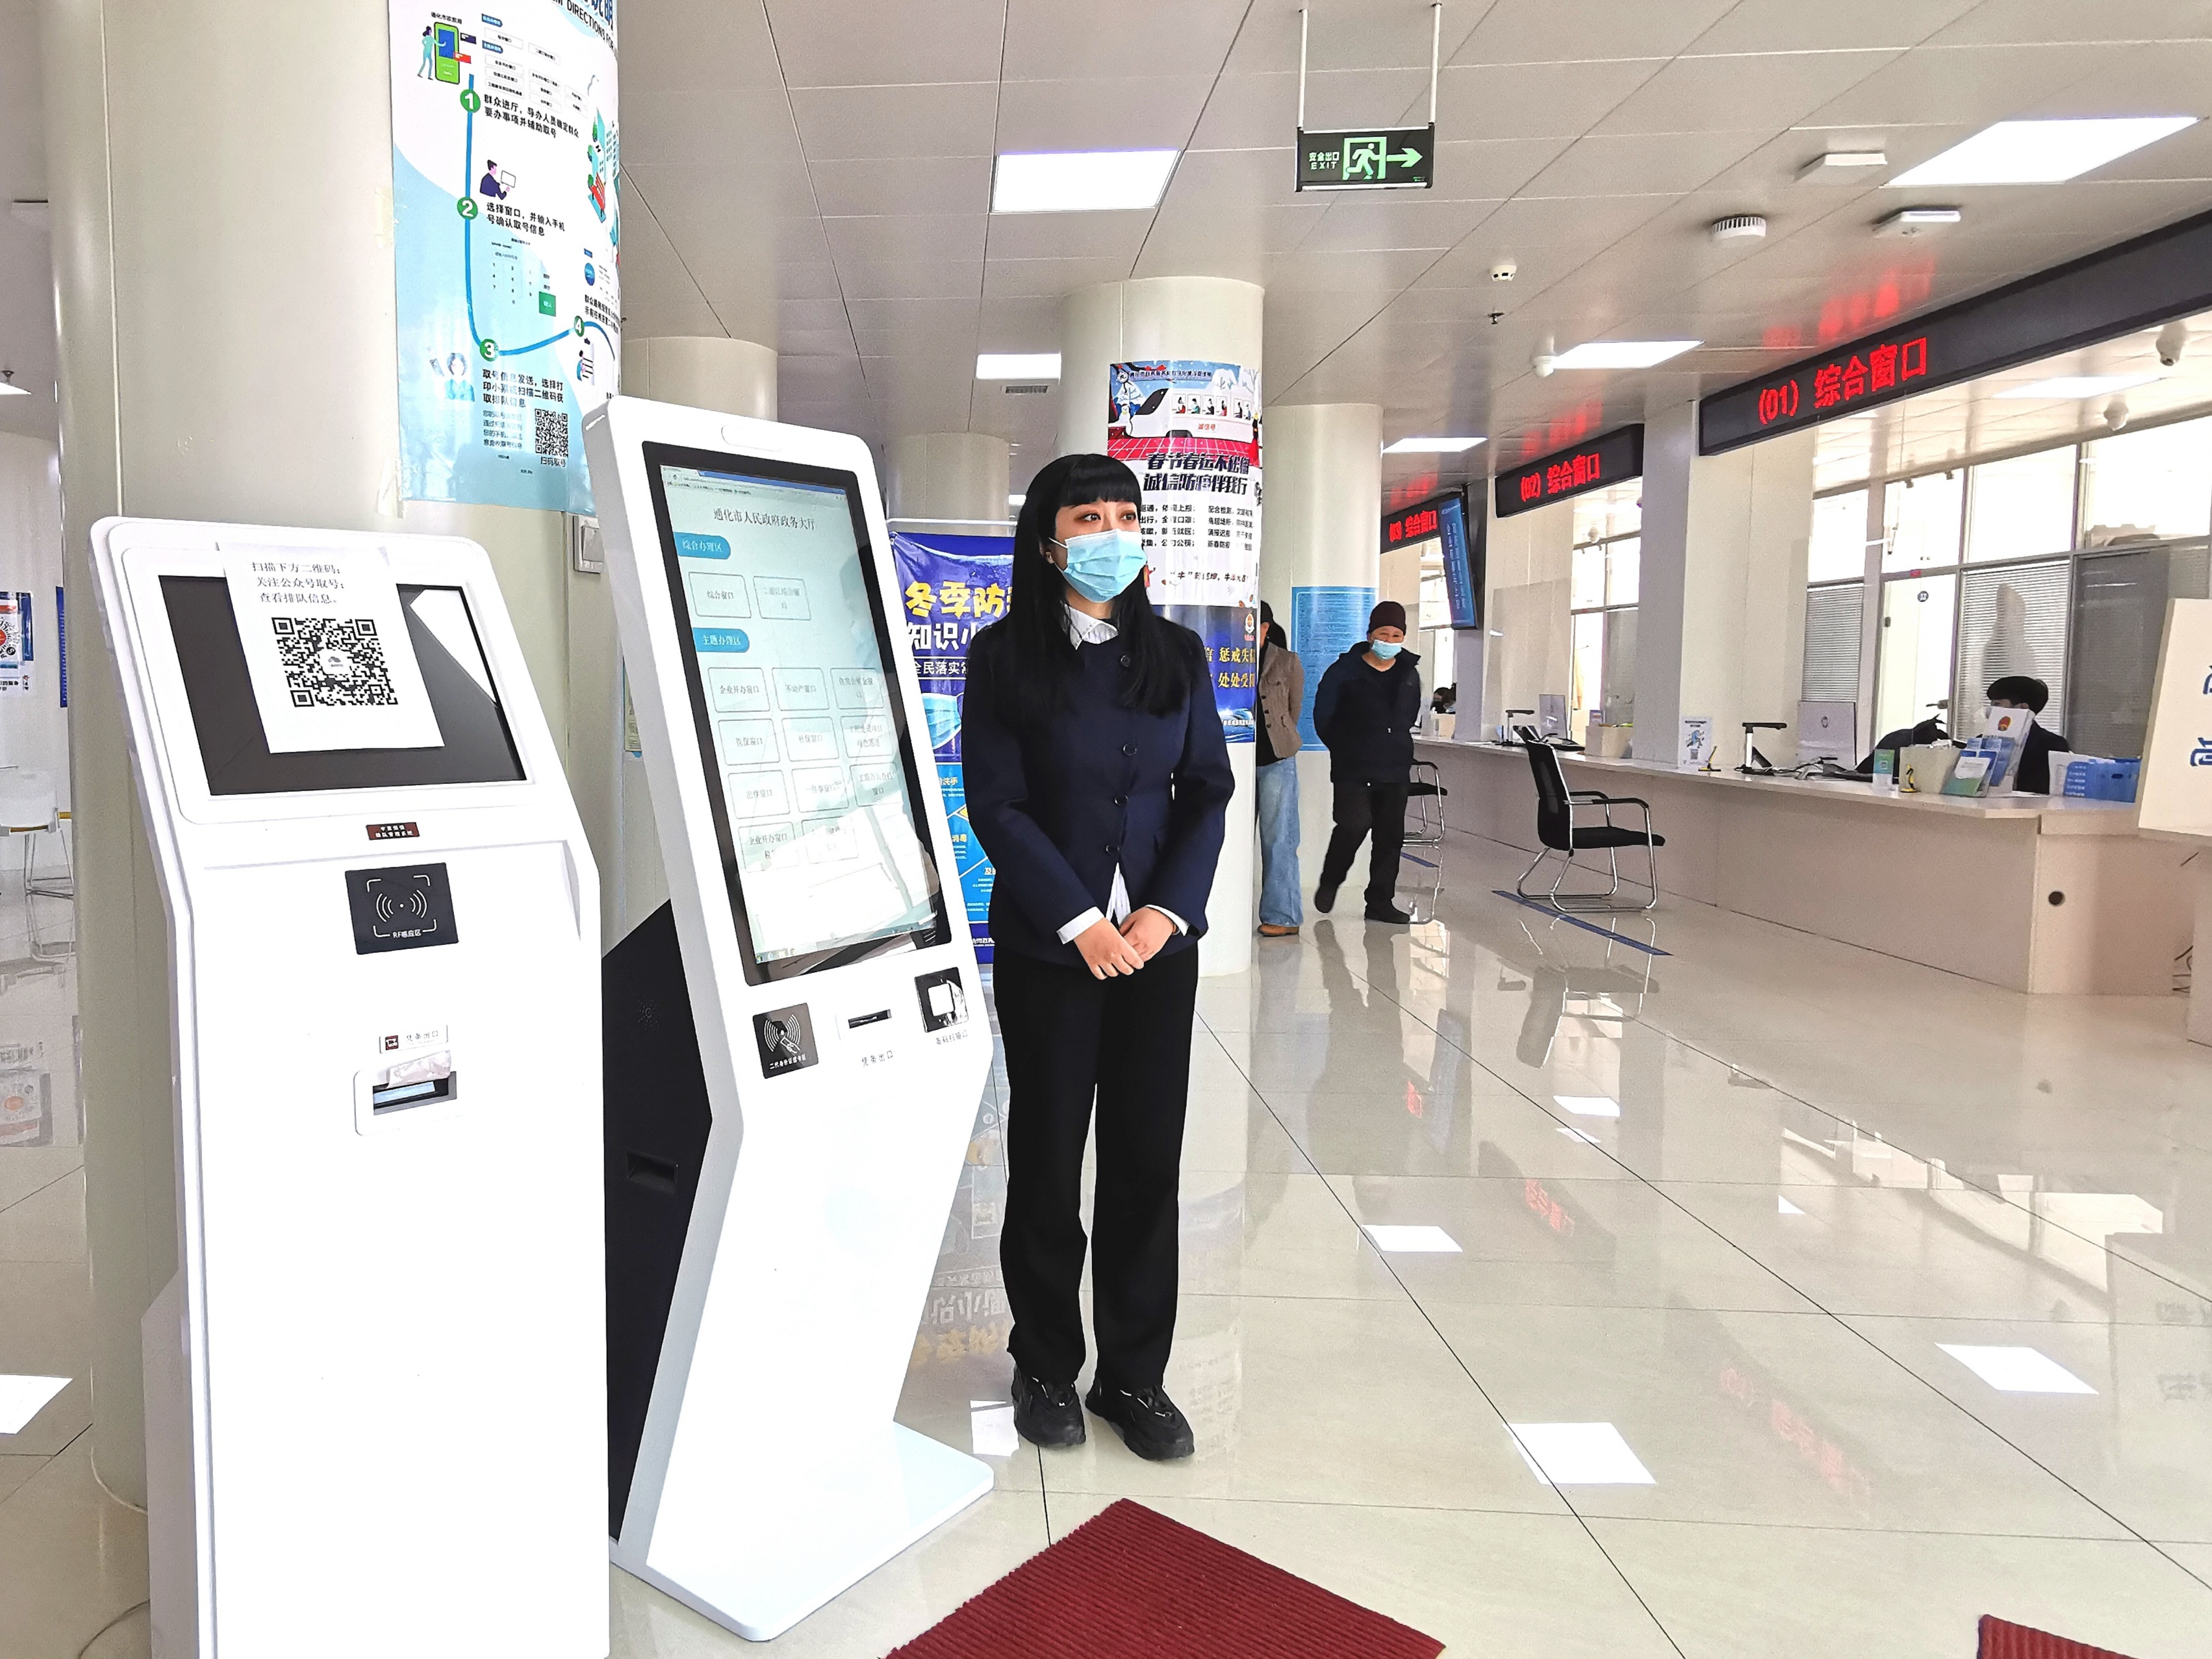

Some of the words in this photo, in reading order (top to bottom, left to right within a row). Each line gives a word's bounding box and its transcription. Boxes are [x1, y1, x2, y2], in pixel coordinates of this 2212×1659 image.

[567, 0, 605, 40] DIRECTIONS
[465, 93, 475, 110] 1
[484, 106, 557, 138] 要办事项并辅助取号
[1308, 151, 1340, 162] 安全出口
[1310, 162, 1337, 170] EXIT
[462, 199, 474, 217] 2
[487, 214, 545, 236] 号确认取号信息
[484, 342, 495, 359] 3
[1758, 379, 1799, 424] (01)
[1813, 337, 1927, 409] 综合窗口
[483, 393, 526, 408] 取排队信息
[540, 456, 566, 467] 扫码取号
[1547, 453, 1600, 494] 综合窗口
[1143, 472, 1249, 495] 诚信防疫伴我行
[714, 507, 815, 530] 通化市人民政府政务大厅
[1405, 510, 1438, 538] 综合窗口
[260, 592, 337, 604] 查看排队信息。
[707, 590, 734, 600] 综合窗口
